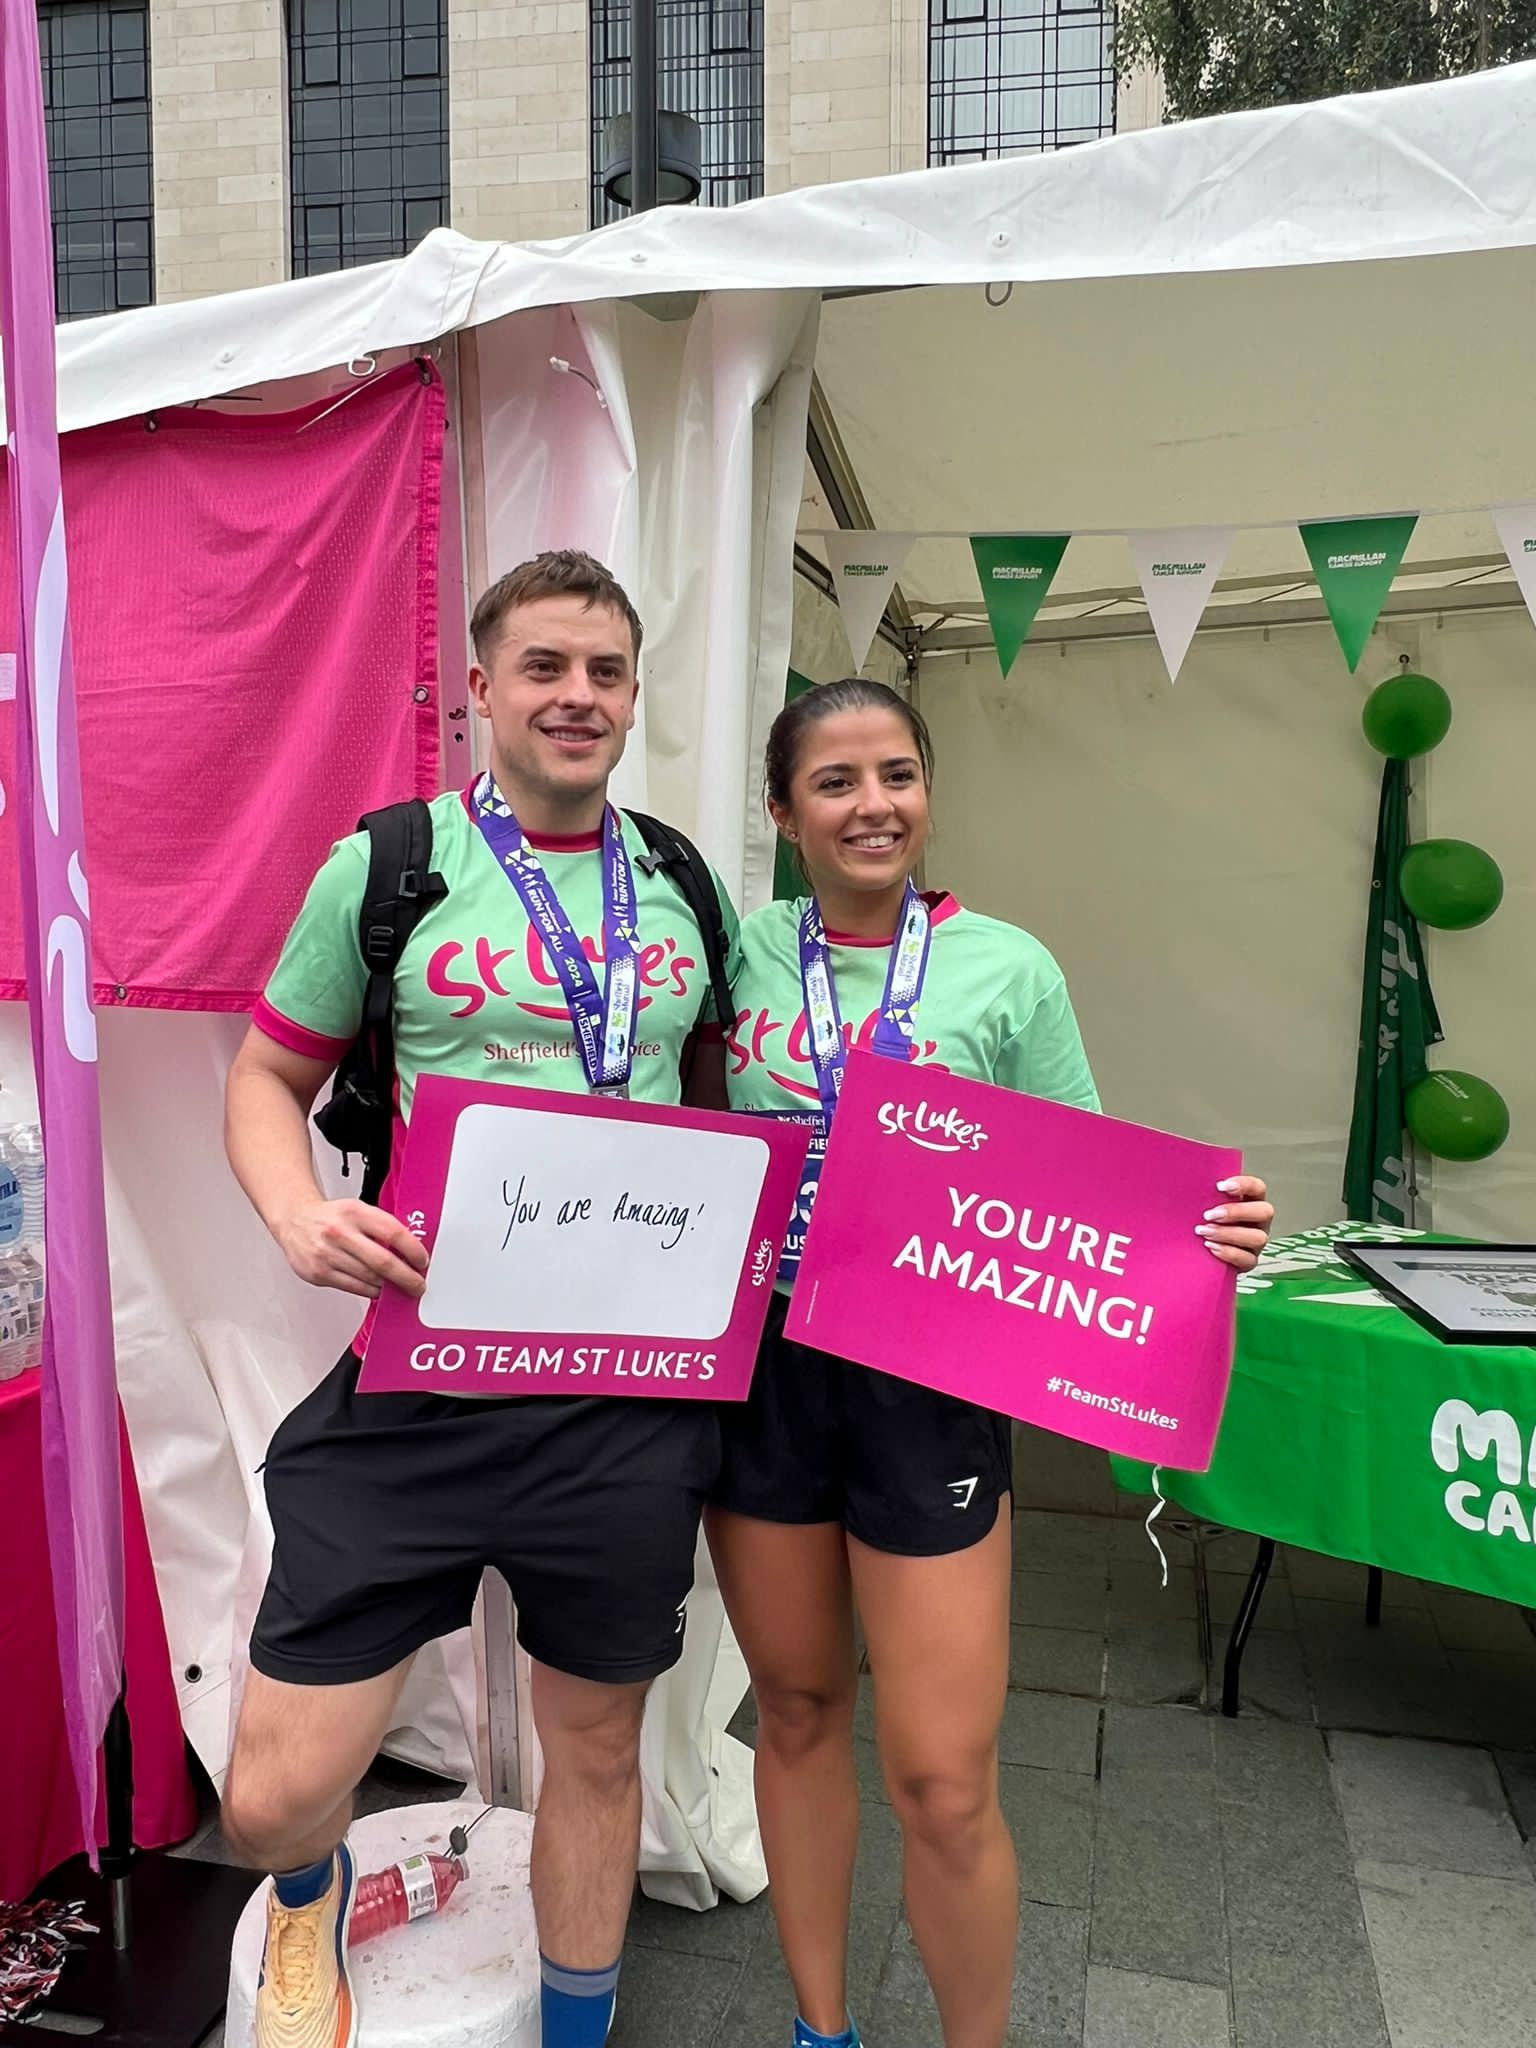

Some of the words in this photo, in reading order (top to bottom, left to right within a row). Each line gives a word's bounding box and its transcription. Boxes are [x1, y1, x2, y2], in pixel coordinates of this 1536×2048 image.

[1152, 563, 1206, 571] MACMILLAN
[1328, 553, 1386, 562] MACMILLAN
[526, 888, 544, 912] RUN
[538, 912, 555, 933] FOR
[548, 934, 565, 953] ALL
[564, 956, 584, 987] 2024
[579, 1018, 597, 1068] SHEFFIELD
[878, 1102, 913, 1135] St
[914, 1101, 989, 1151] Luke's
[501, 1175, 541, 1250] You
[557, 1198, 592, 1225] are
[612, 1191, 705, 1249] Amazing!
[948, 1186, 1132, 1276] YOU'RE
[892, 1234, 1154, 1345] AMAZING!
[410, 1343, 465, 1372] GO
[474, 1345, 564, 1374] TEAM
[568, 1347, 610, 1375] ST
[614, 1349, 717, 1380] LUKE'S
[1046, 1376, 1179, 1430] #TeamStLukes
[1445, 1480, 1536, 1544] CA
